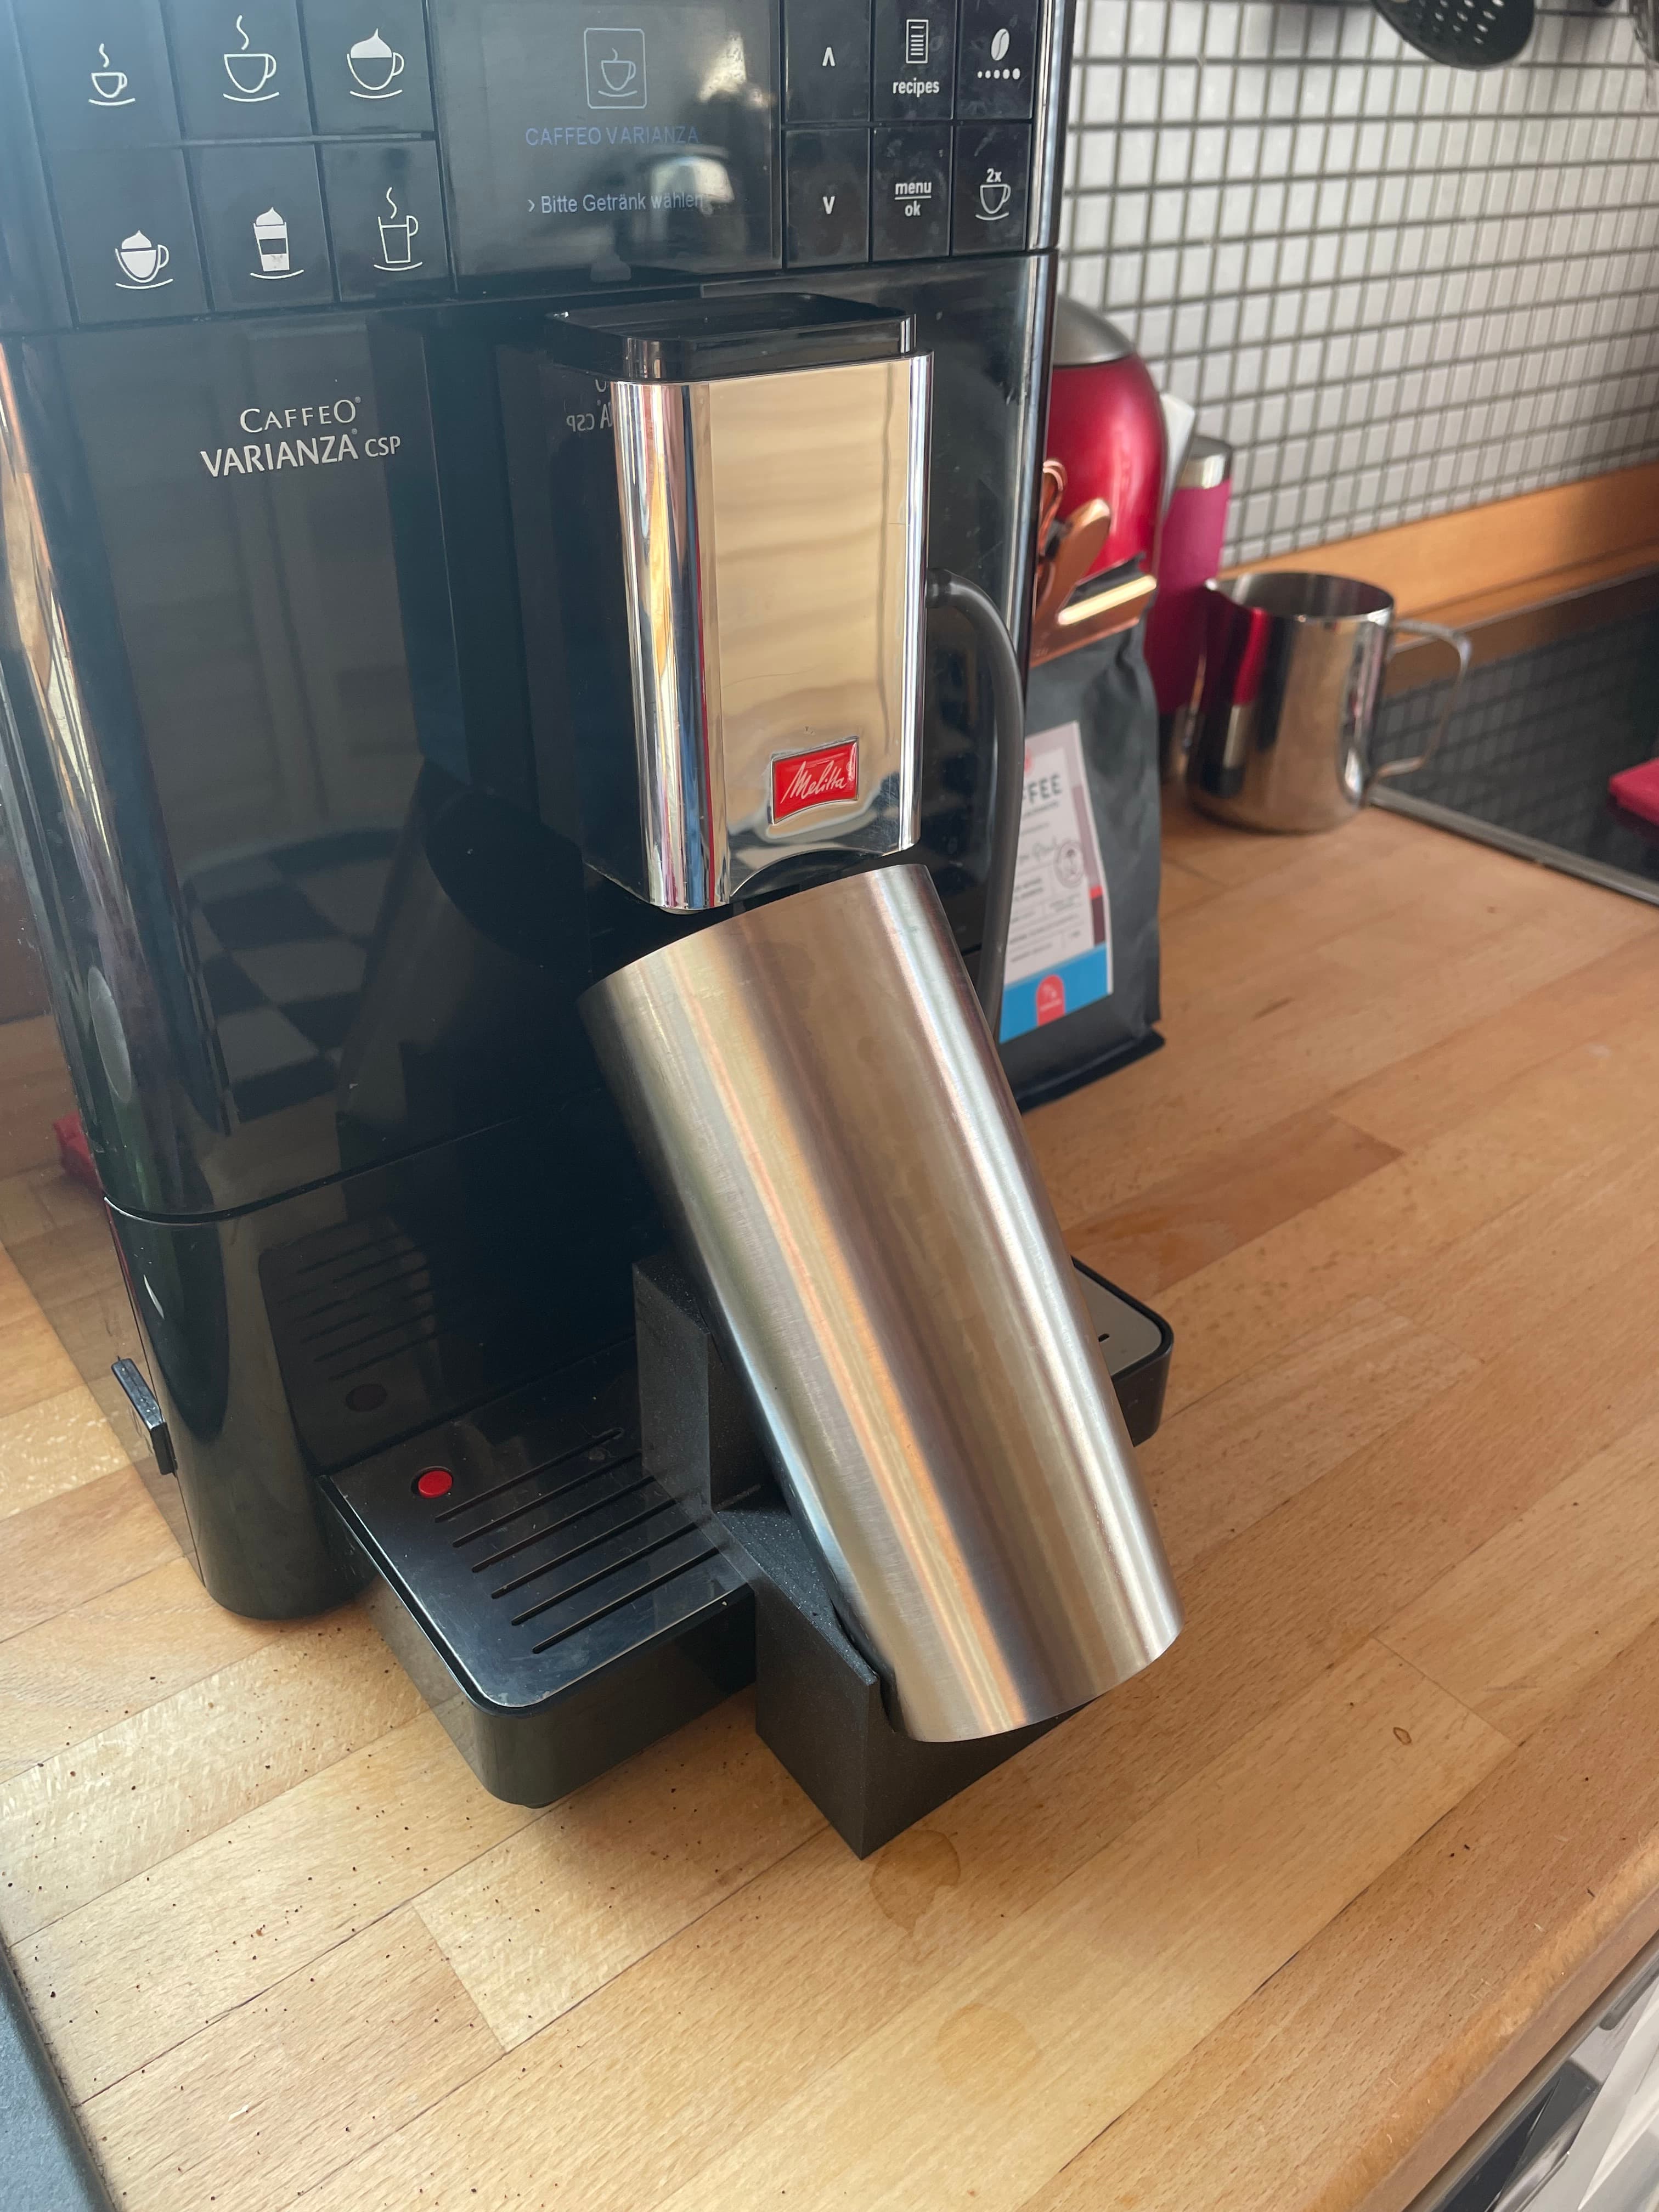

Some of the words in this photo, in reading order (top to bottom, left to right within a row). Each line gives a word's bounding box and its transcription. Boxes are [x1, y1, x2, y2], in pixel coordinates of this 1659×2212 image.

[892, 77, 940, 98] recipes
[525, 127, 601, 145] CAFFEO
[605, 126, 699, 144] VARIANZA
[986, 168, 1002, 183] 2x
[895, 182, 932, 195] menu
[541, 195, 577, 213] Bitte
[583, 193, 645, 212] Getränk
[651, 192, 703, 209] wählen
[905, 200, 921, 216] ok
[200, 433, 359, 477] VARIANZA
[364, 436, 401, 458] CSP
[1023, 773, 1063, 805] FEE
